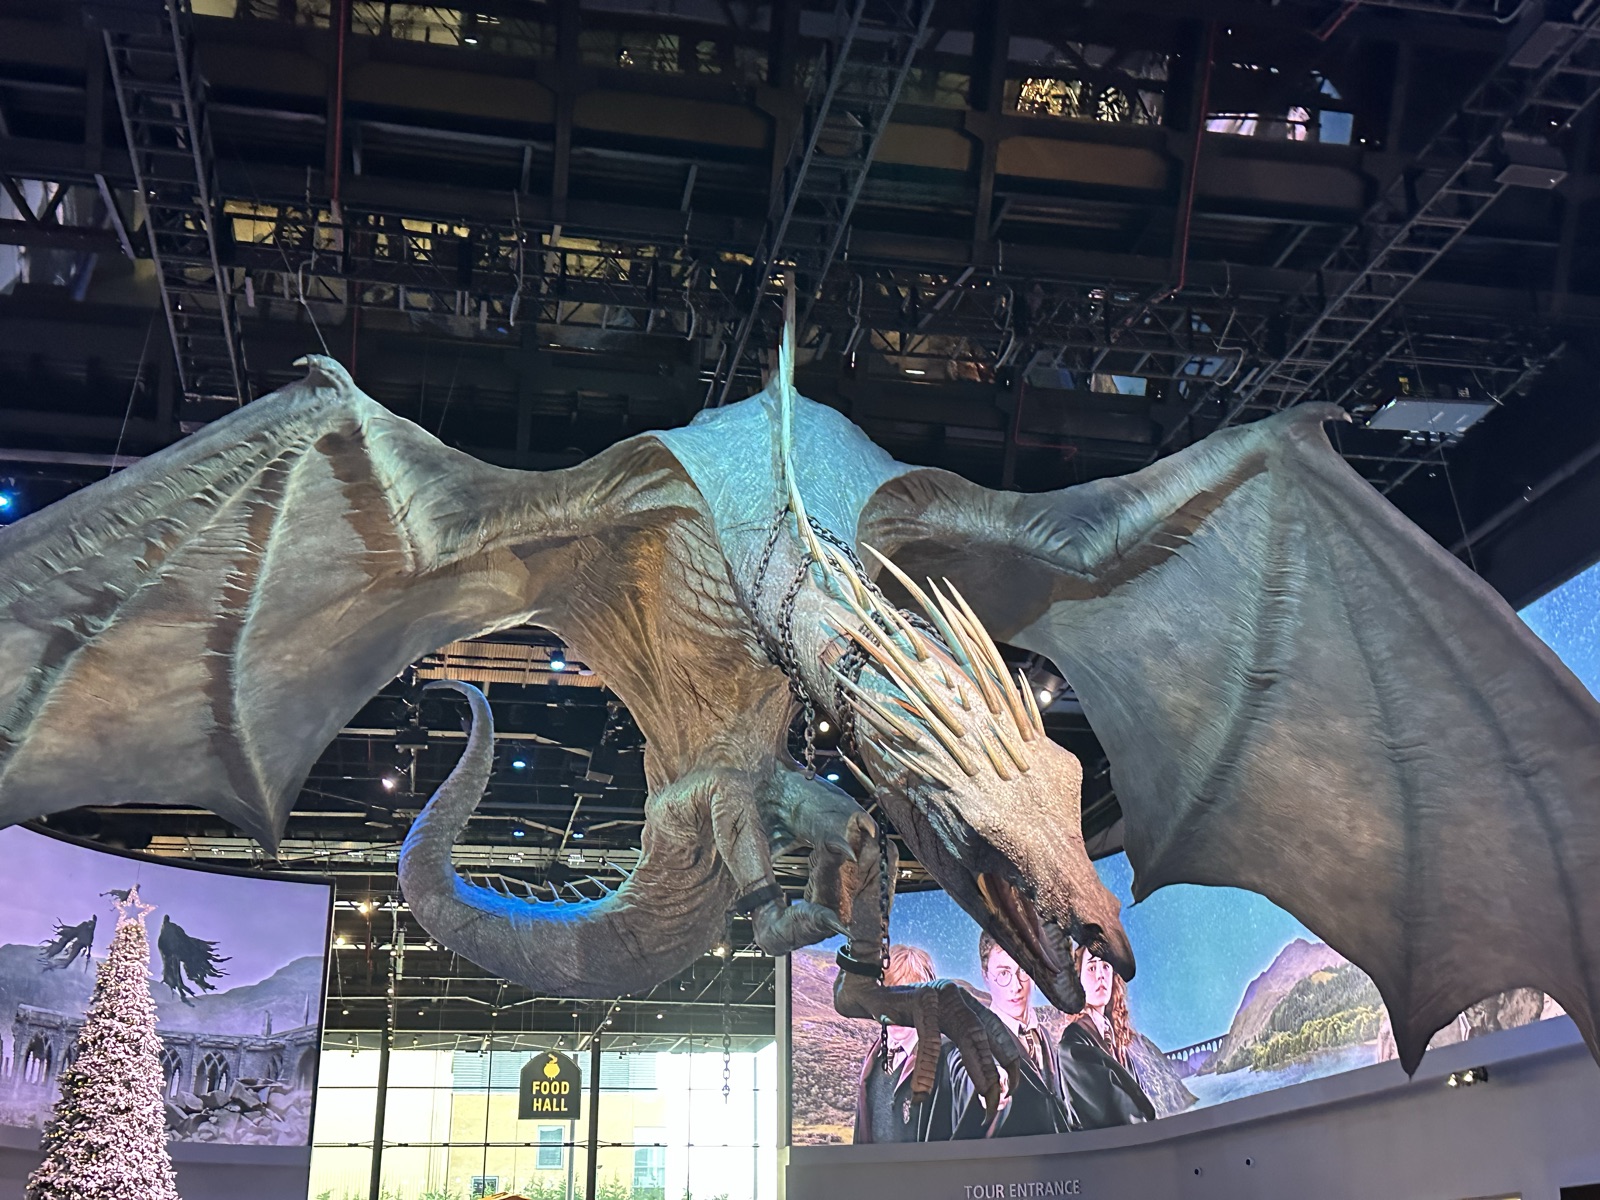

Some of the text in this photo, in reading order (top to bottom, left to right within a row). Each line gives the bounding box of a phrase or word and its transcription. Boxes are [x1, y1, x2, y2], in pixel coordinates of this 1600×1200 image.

[532, 1081, 570, 1095] FOOD
[532, 1098, 568, 1112] HALL
[964, 1180, 1080, 1199] TOUR ENTRANCE
